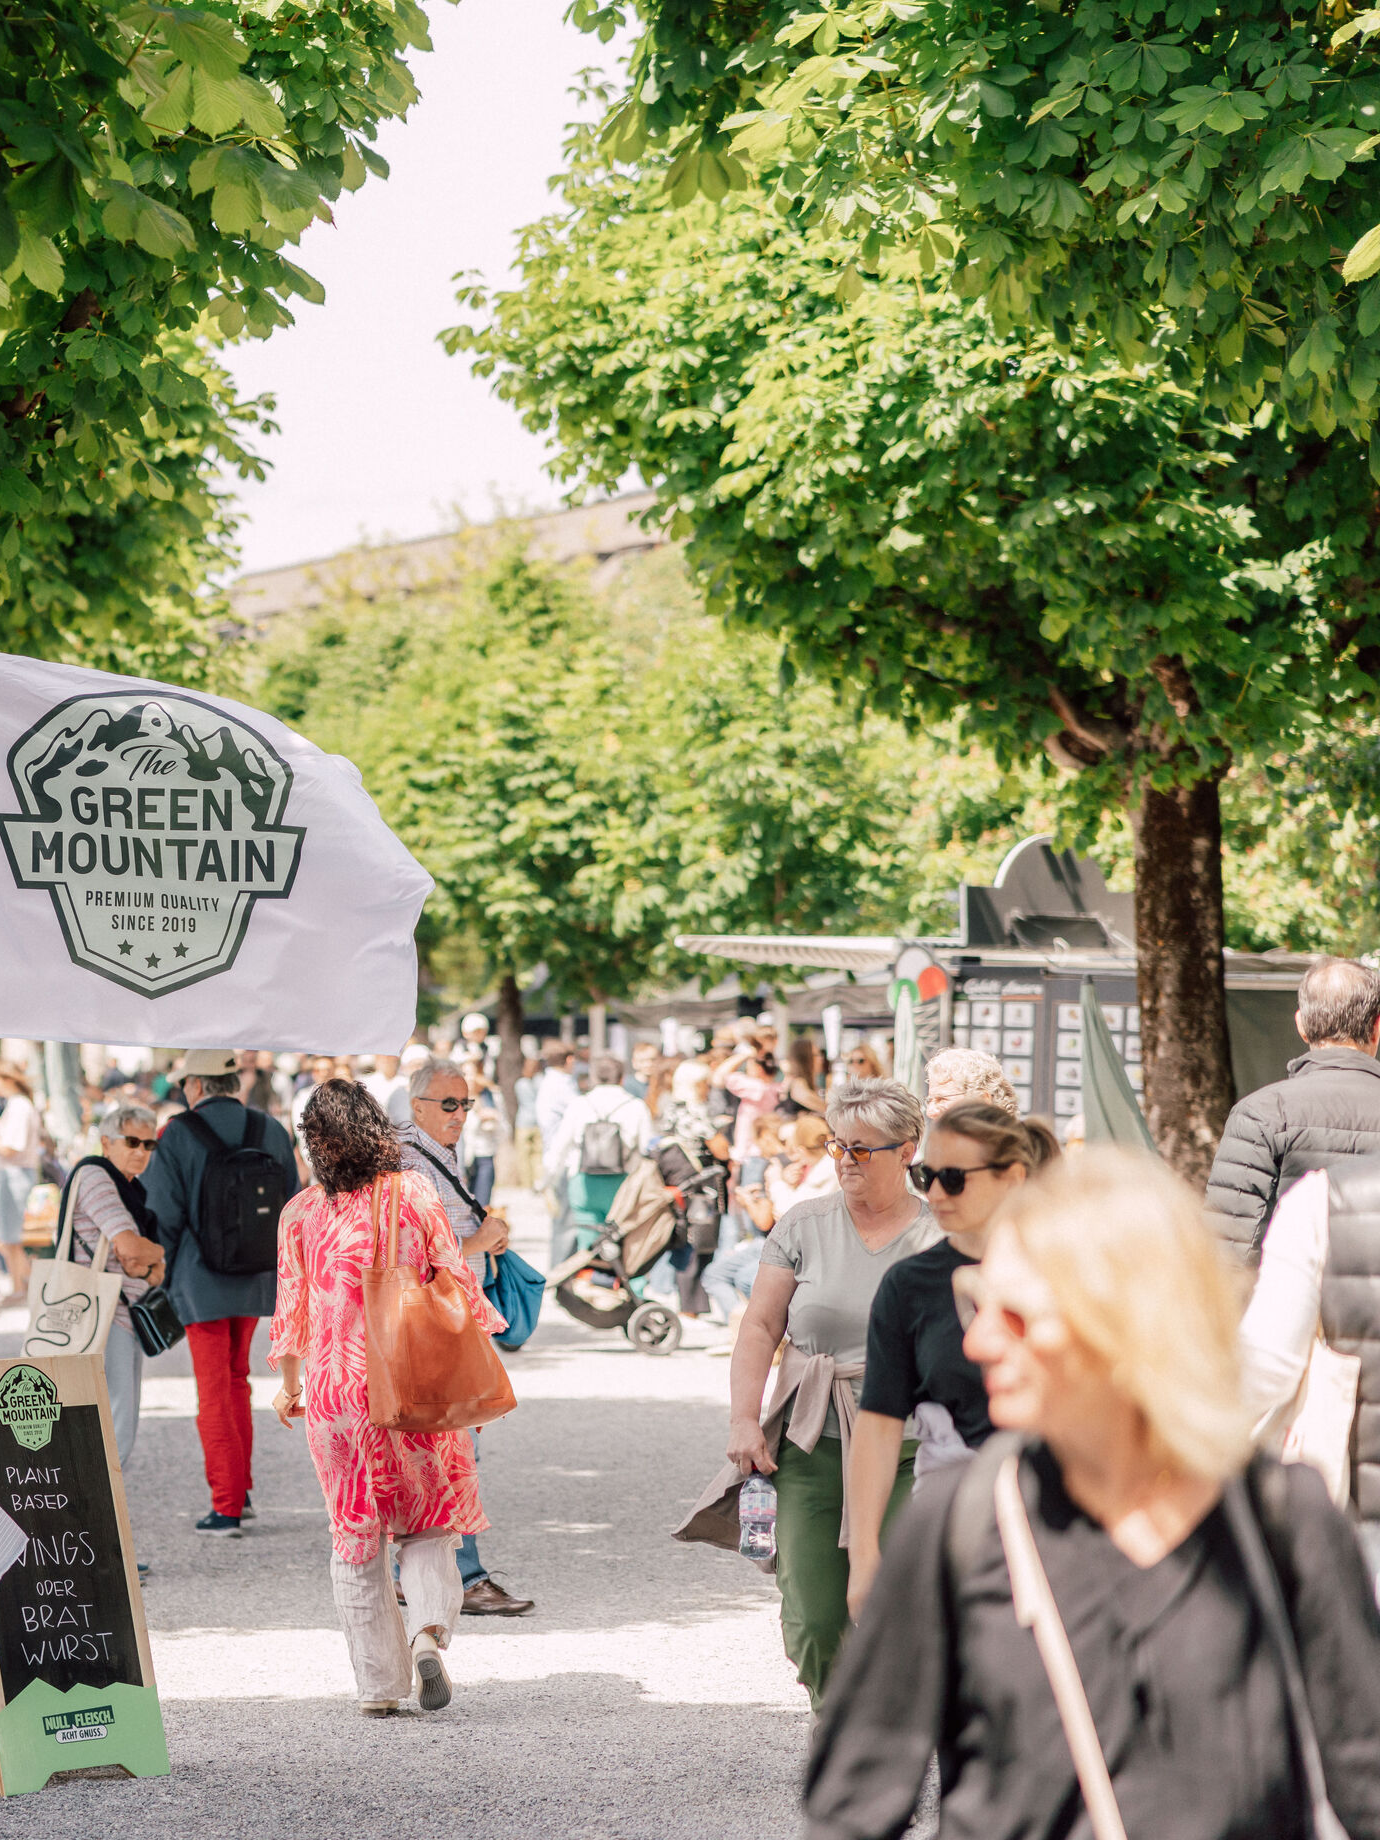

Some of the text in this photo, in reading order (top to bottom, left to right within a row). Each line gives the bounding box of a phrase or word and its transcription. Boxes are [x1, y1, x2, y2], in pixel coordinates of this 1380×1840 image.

[120, 744, 179, 781] The
[70, 786, 233, 832] GREEN
[31, 830, 276, 883] MOUNTAIN
[85, 890, 220, 912] PREMIUM QUALITY
[111, 914, 196, 933] SINCE 2019
[9, 1394, 46, 1408] GREEN
[2, 1406, 58, 1423] MOUNTAIN
[5, 1466, 61, 1485] PLANT
[11, 1494, 68, 1511] BASED
[36, 1579, 77, 1597] ODER
[21, 1604, 93, 1632] BRAT
[20, 1632, 113, 1666] WURST
[44, 1709, 114, 1730] NULL FLEISCH.
[80, 1727, 103, 1739] GNUSS.
